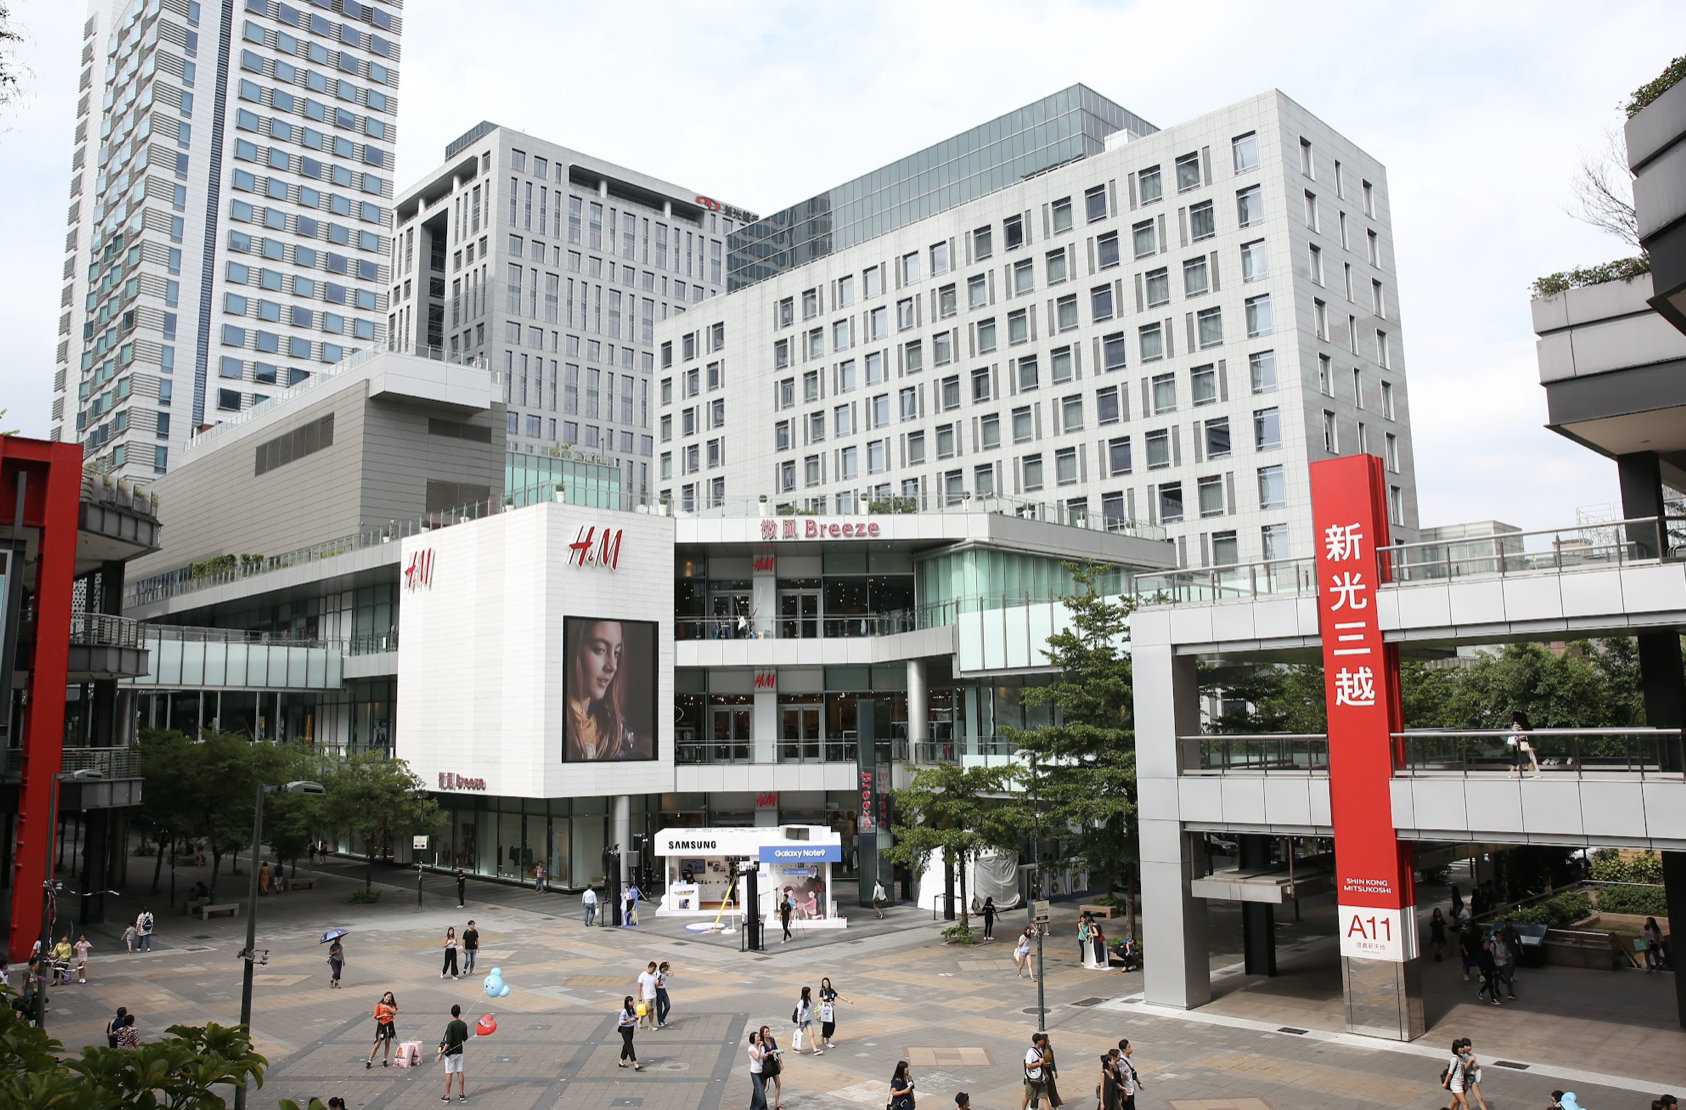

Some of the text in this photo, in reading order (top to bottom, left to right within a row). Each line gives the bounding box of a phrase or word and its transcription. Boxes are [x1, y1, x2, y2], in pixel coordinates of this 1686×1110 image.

[805, 519, 880, 537] Breeze
[569, 525, 623, 570] H&M
[1324, 522, 1375, 706] 新光三越
[754, 673, 775, 689] H&M
[861, 771, 872, 830] Breeze
[878, 771, 888, 830] Breeze
[668, 840, 717, 850] SAMSUNG
[774, 848, 826, 859] Galaxy Note9
[1343, 885, 1391, 894] MITSUKOSHI
[1347, 914, 1391, 942] A11
